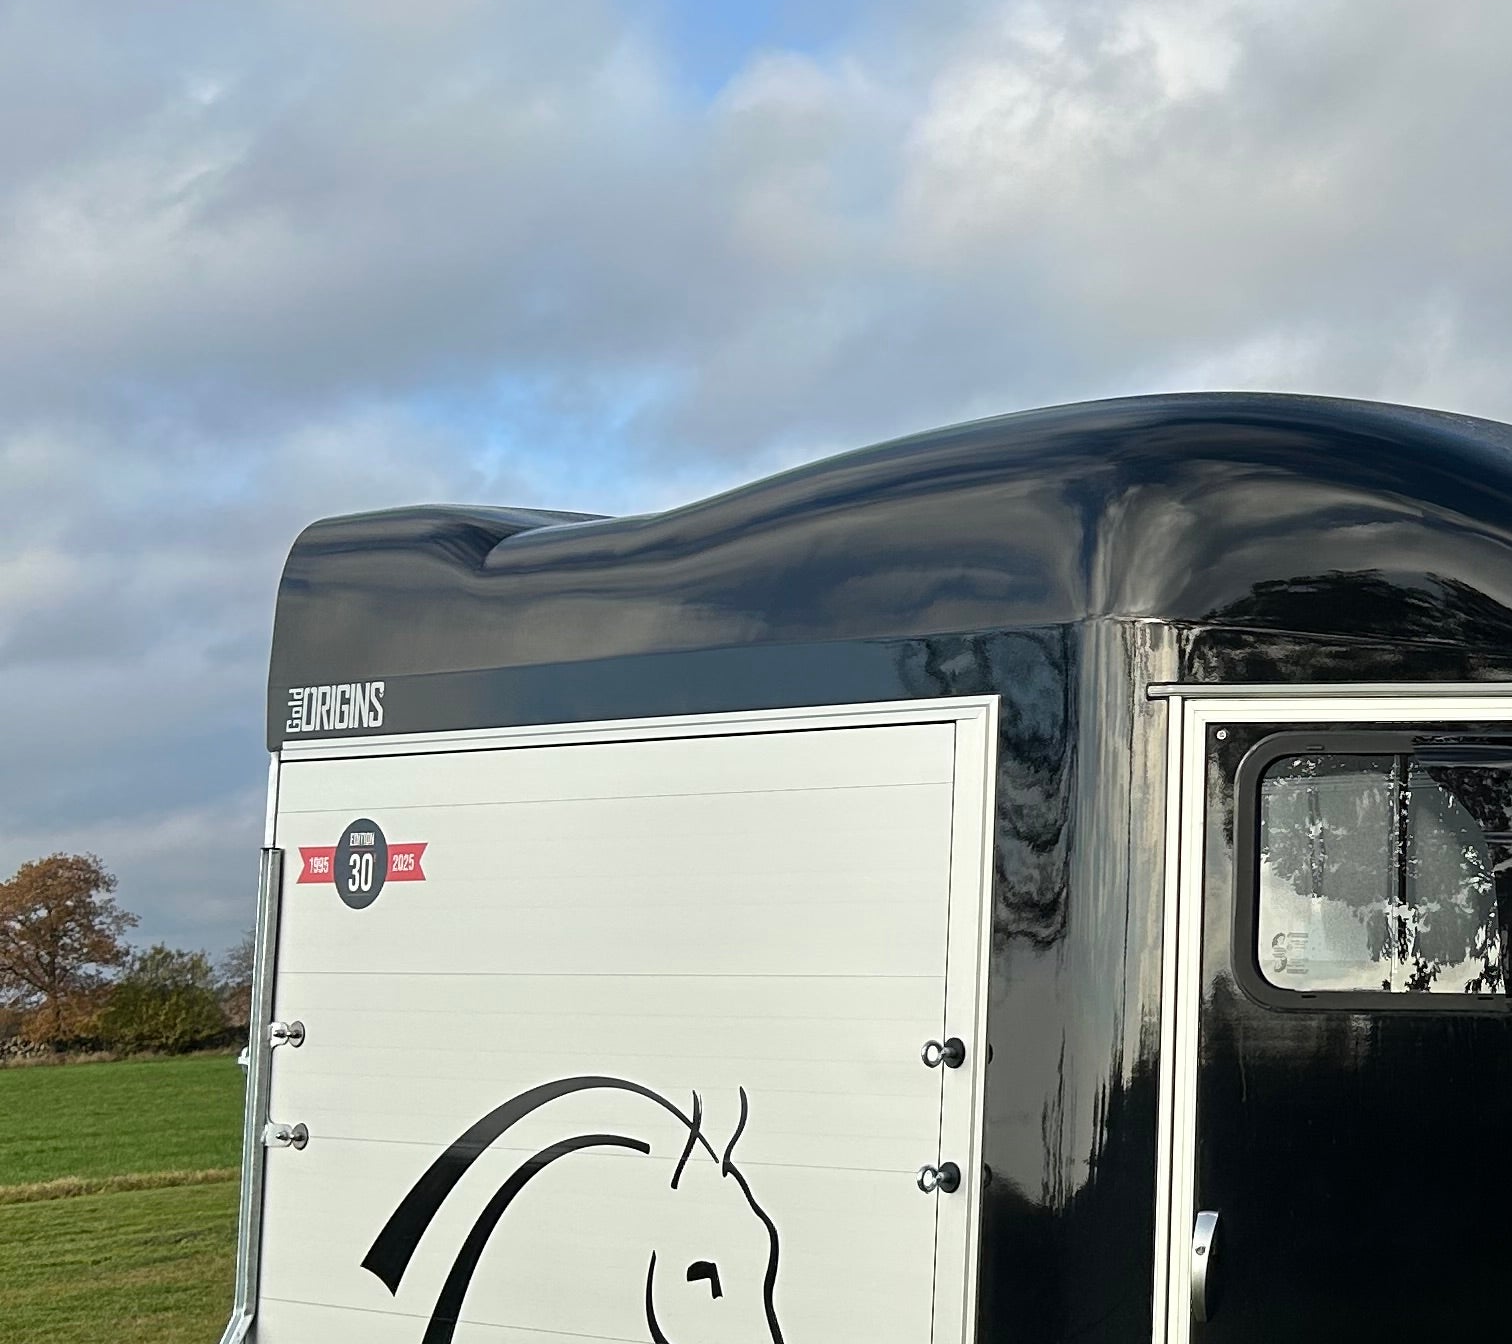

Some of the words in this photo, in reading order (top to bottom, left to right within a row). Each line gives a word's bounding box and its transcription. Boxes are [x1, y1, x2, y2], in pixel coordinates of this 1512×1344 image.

[286, 687, 304, 733] Gold
[301, 681, 385, 732] ORIGINS
[309, 856, 329, 874] 1995
[348, 853, 374, 892] 30
[392, 853, 415, 872] 2025
